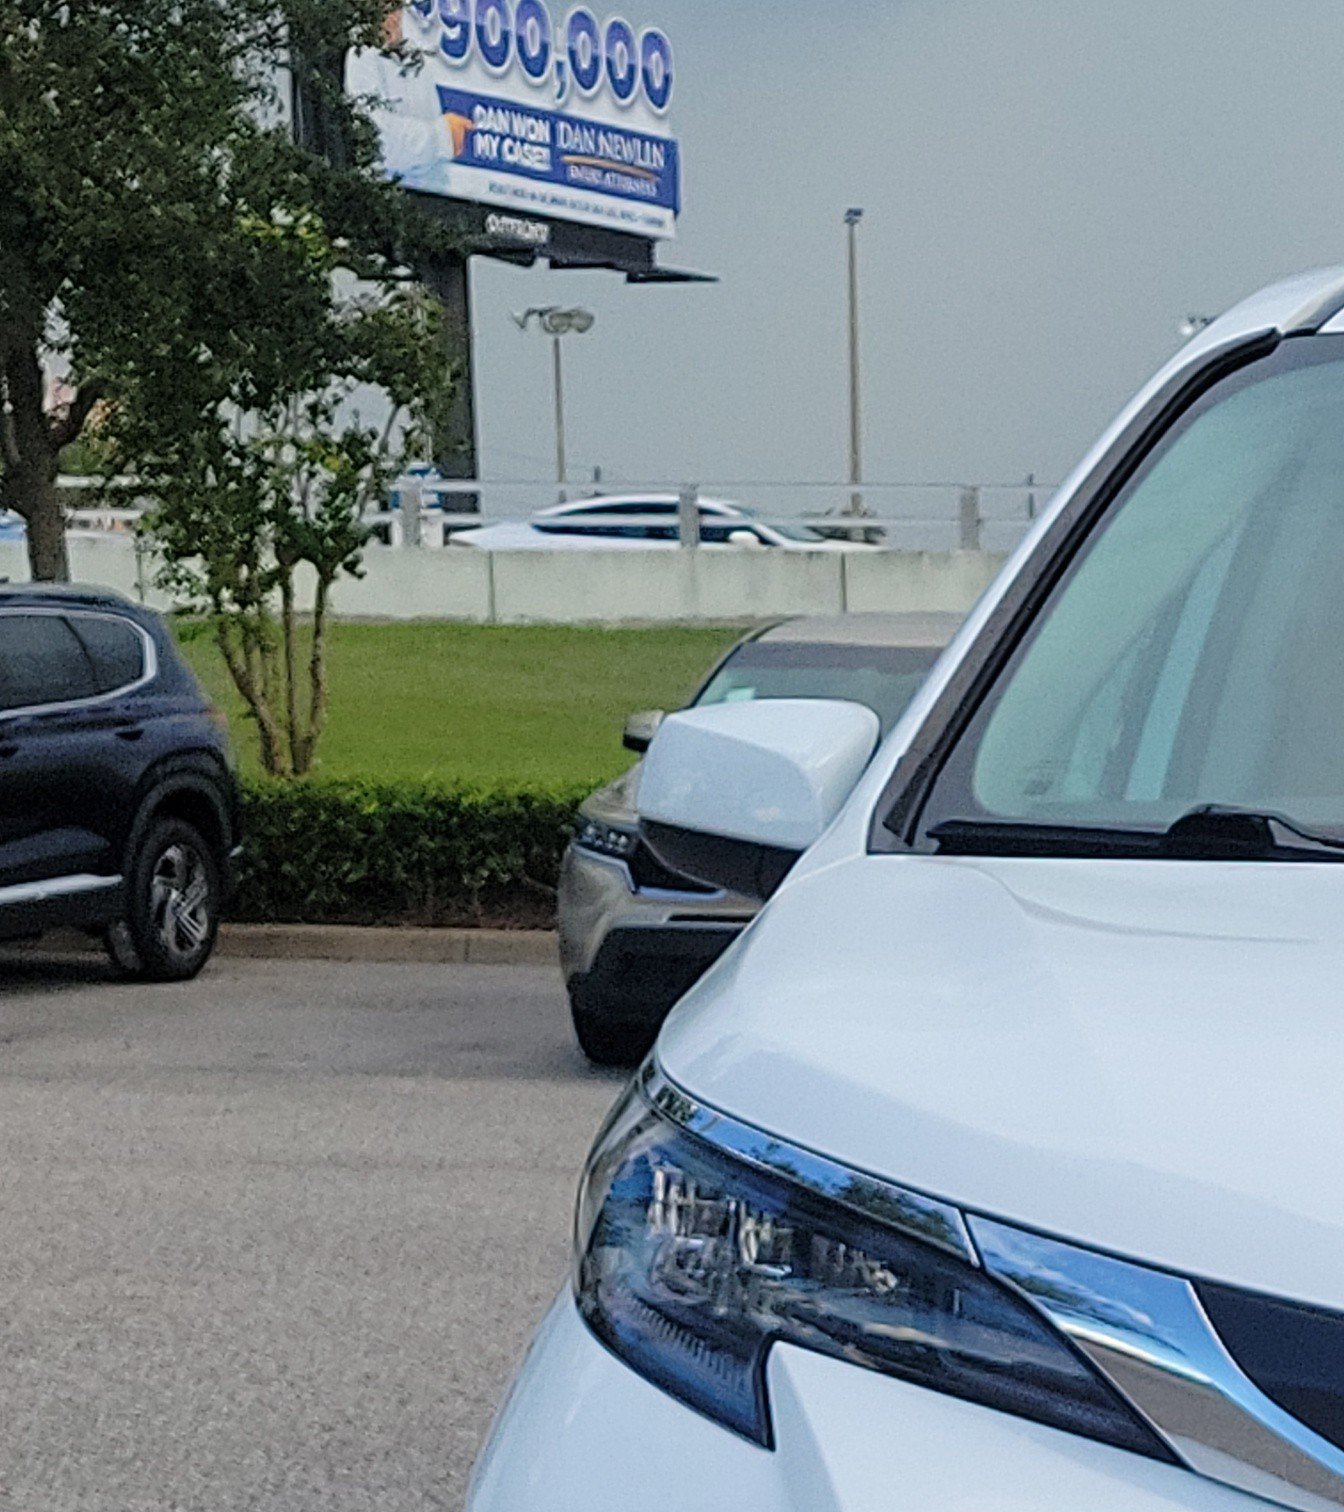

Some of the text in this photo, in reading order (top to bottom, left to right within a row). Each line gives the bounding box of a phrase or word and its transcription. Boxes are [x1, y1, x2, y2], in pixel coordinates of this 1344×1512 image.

[473, 104, 551, 143] DAN WON
[473, 132, 500, 161] MY
[556, 120, 665, 168] DAN NEWLIN
